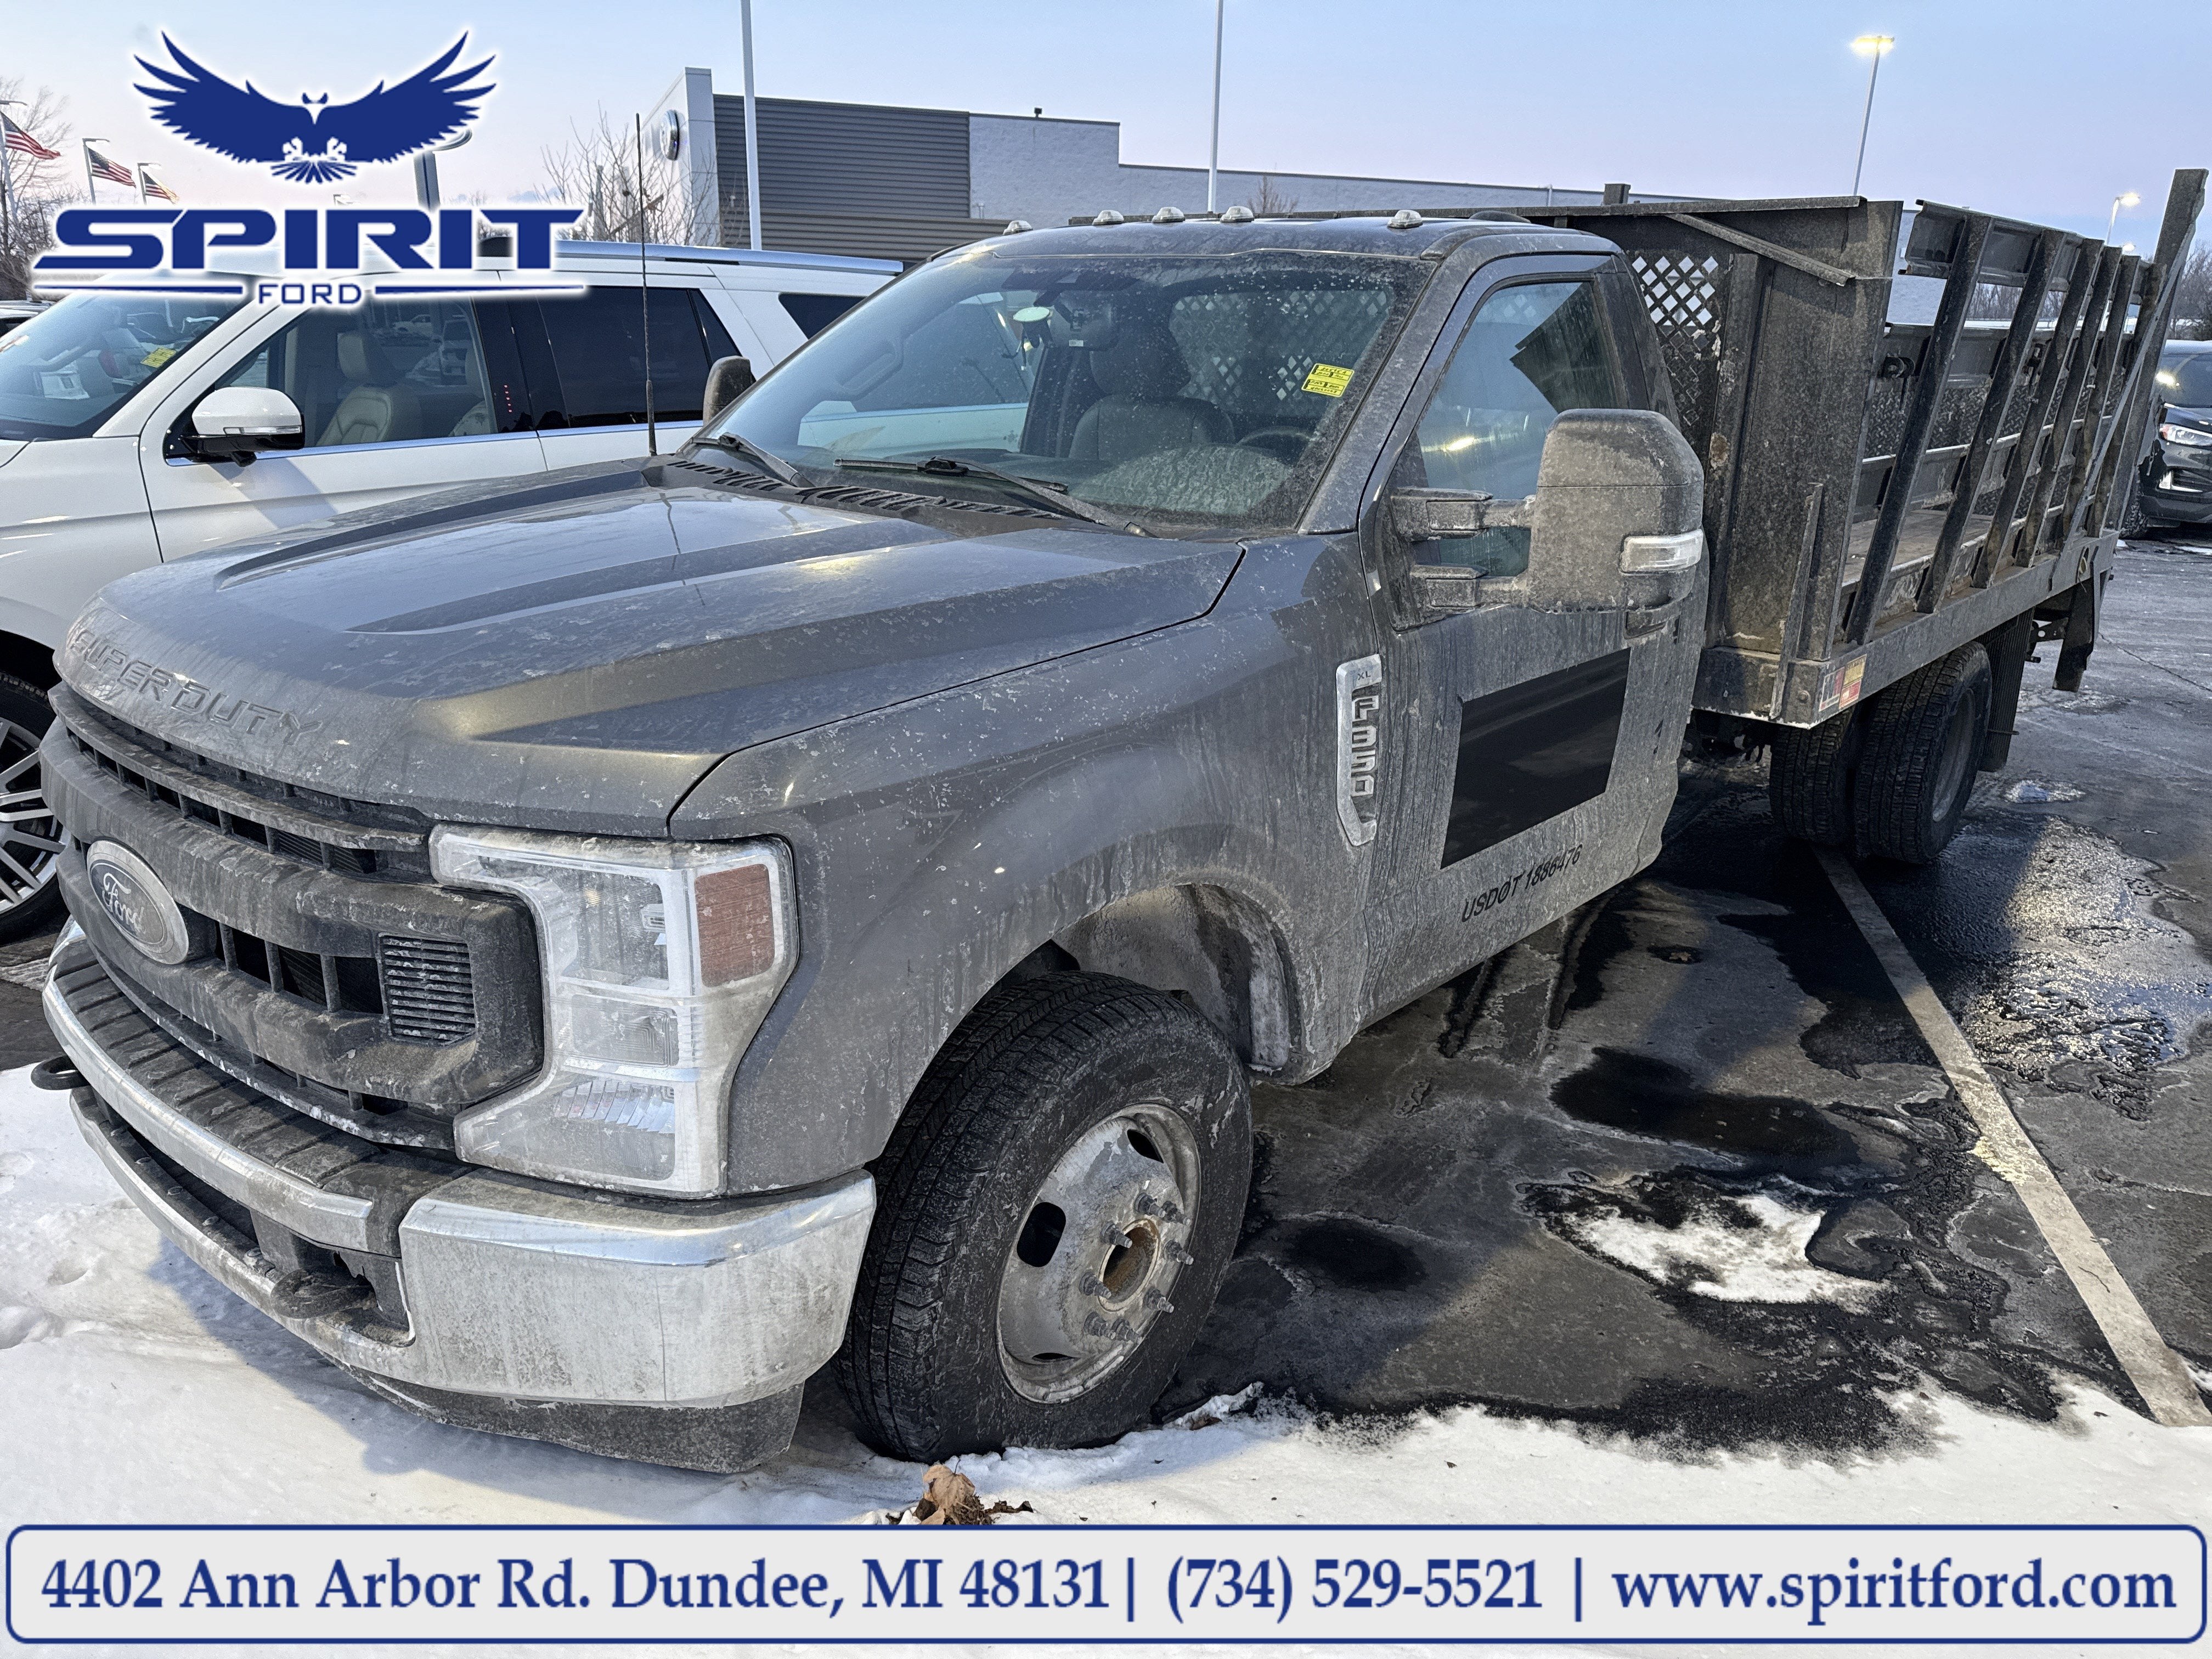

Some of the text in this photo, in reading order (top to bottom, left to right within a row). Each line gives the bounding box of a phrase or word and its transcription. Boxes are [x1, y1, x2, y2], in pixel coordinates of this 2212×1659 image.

[70, 629, 323, 747] SUPER DUTY
[1357, 670, 1371, 680] XL
[102, 872, 146, 933] Ford
[1462, 870, 1526, 923] USDOT
